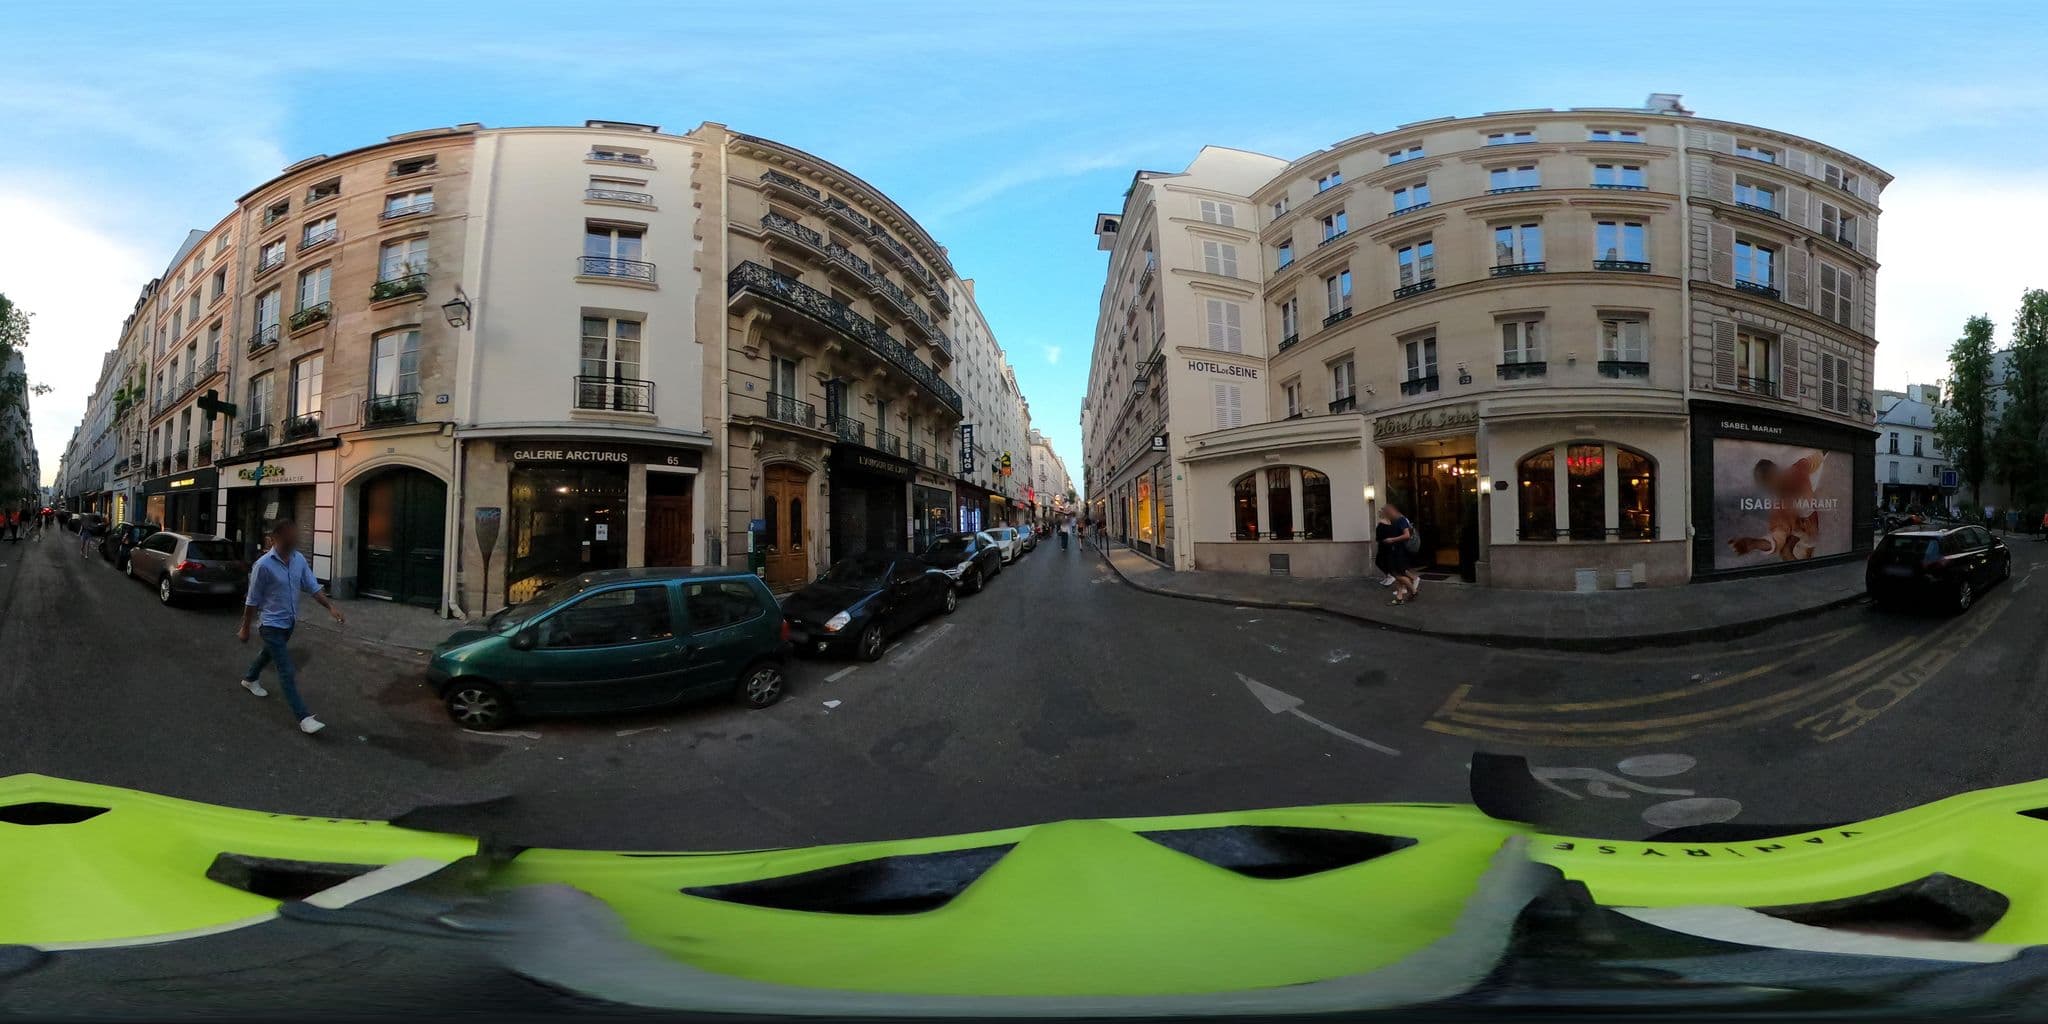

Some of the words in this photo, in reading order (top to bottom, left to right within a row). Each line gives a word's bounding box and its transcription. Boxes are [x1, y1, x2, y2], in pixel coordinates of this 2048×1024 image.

[1188, 360, 1222, 374] HOTEL
[1228, 365, 1258, 379] SEINE
[1721, 421, 1749, 431] ISABEL
[1752, 424, 1783, 434] MARANT
[1154, 437, 1163, 446] B
[513, 450, 564, 460] GALERIE
[565, 451, 629, 462] ARCTURUS
[667, 456, 679, 465] 65
[1740, 498, 1785, 511] ISABEL
[1793, 498, 1839, 510] MARANT
